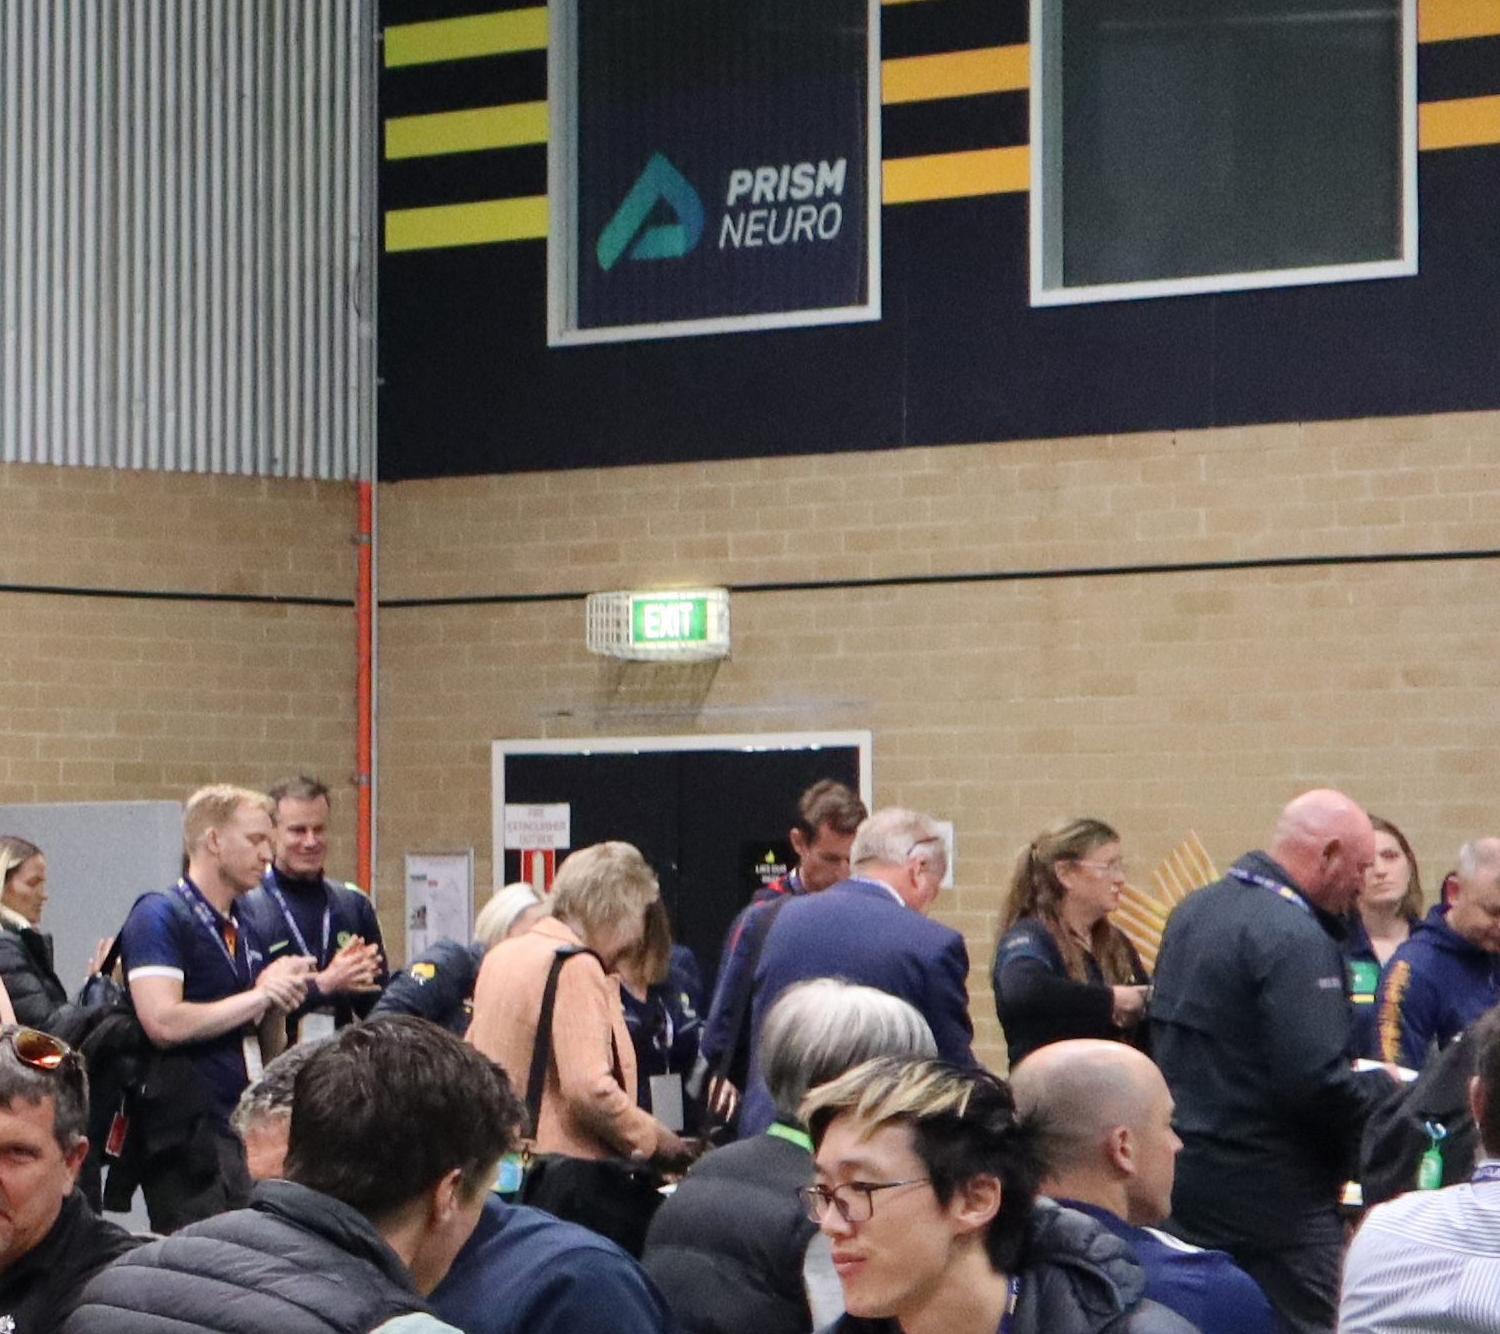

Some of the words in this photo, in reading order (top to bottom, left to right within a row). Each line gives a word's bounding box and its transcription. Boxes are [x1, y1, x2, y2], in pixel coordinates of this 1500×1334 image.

[726, 156, 847, 206] PRISM
[718, 200, 843, 249] NEURO
[644, 601, 695, 639] EXIT
